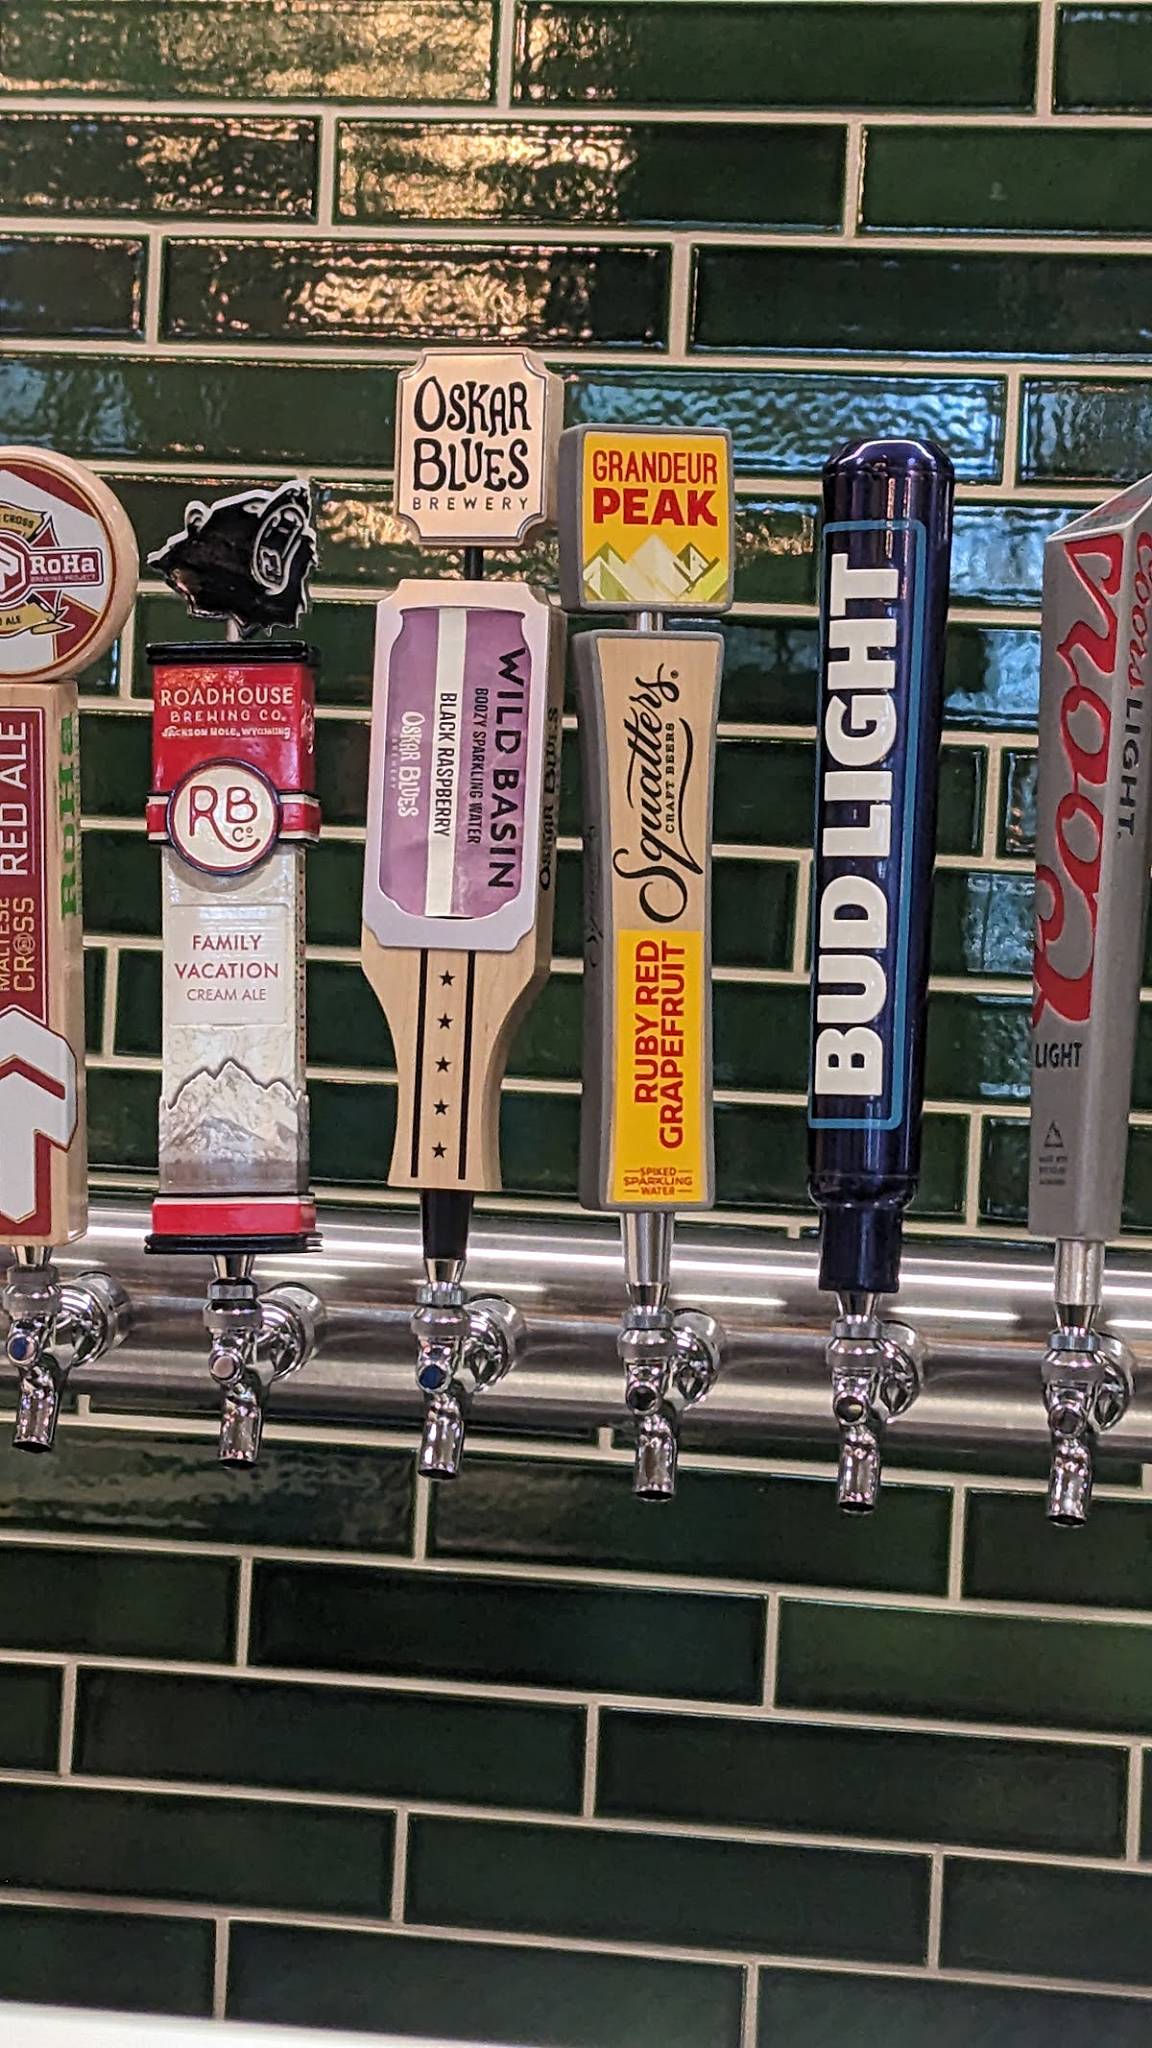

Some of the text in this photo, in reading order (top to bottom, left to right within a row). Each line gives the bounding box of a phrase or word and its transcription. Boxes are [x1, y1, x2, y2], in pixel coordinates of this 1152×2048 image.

[413, 375, 532, 438] OSKAR
[413, 438, 530, 492] BLUES
[592, 449, 718, 484] GRANDEUR
[412, 497, 528, 511] BREWERY
[592, 487, 718, 527] PEAK
[29, 554, 96, 575] RoHa
[160, 686, 294, 706] ROADHOUSE
[170, 710, 287, 723] BREWING CO.
[433, 692, 457, 837] BLACK RASPBERRY
[466, 687, 489, 844] BOOZY SPARKLING WATER
[488, 647, 526, 888] WILD BASIN
[665, 721, 676, 834] CRAFT BEERS
[1032, 532, 1125, 1028] Coors
[1118, 697, 1143, 836] LIGHT
[0, 722, 28, 876] RED ALE
[814, 552, 899, 1096] BUD LIGHT
[192, 934, 262, 951] FAMILY
[174, 963, 279, 979] VACATION
[186, 988, 267, 1001] CREAM ALE
[634, 939, 660, 1104] RUBY RED
[659, 940, 686, 1150] GRAPEFRUIT
[1035, 1042, 1082, 1069] LIGHT
[623, 1176, 693, 1186] SPARKLING
[640, 1166, 677, 1176] SPIKED
[640, 1186, 675, 1195] WATER
